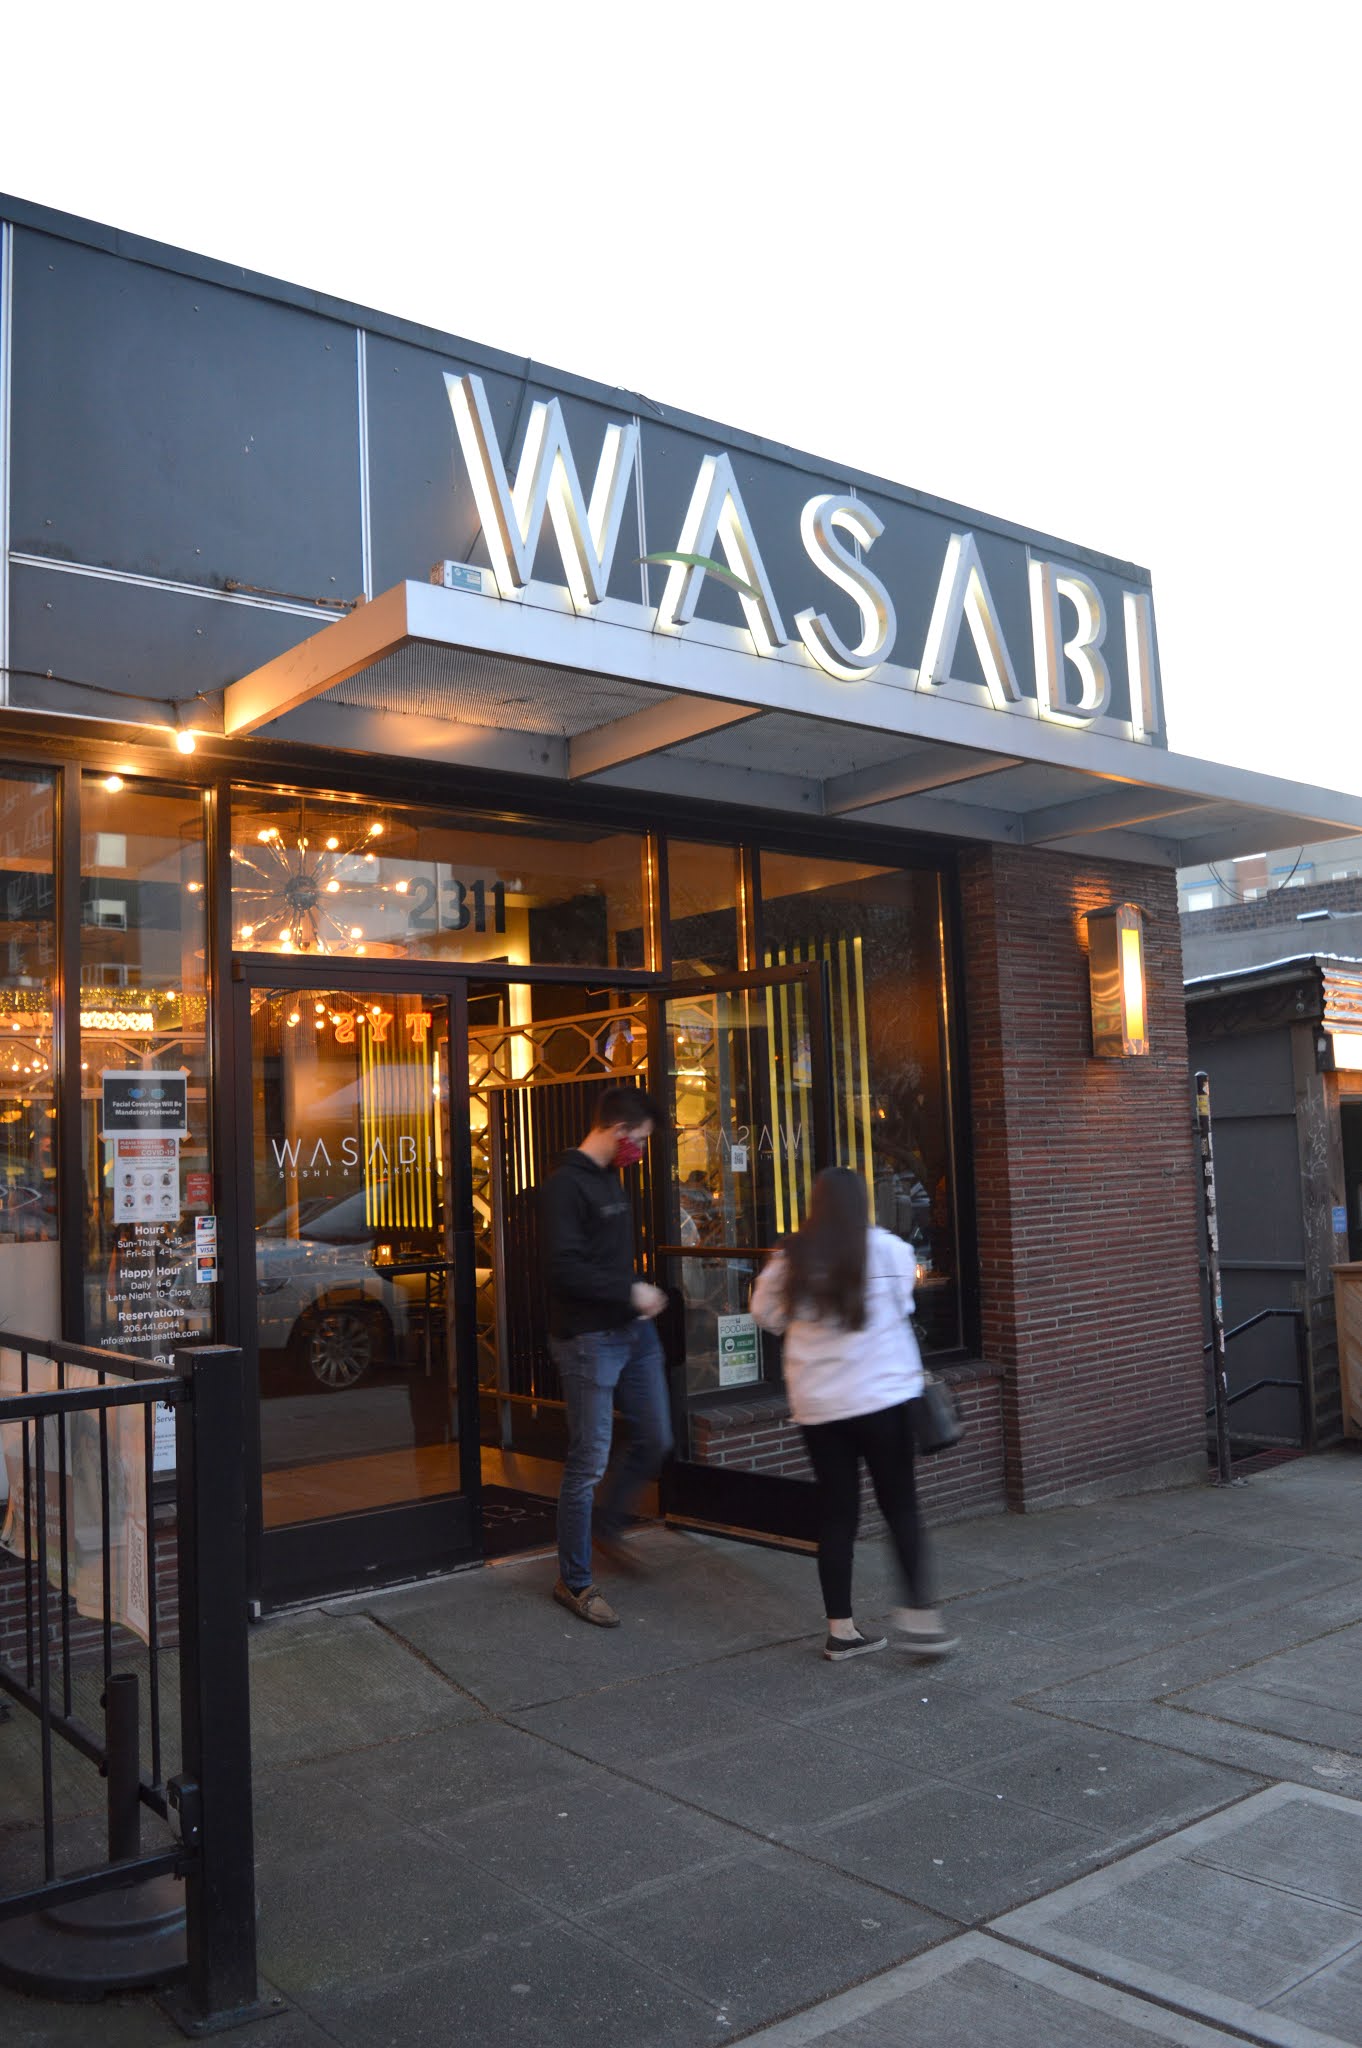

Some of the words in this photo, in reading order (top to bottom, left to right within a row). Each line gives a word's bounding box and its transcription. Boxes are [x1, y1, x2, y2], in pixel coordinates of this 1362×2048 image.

[442, 371, 1158, 743] WASABI
[407, 877, 507, 933] 2311
[131, 1101, 161, 1109] Coverings
[271, 1136, 431, 1168] WASABI
[279, 1170, 329, 1178] SUSHI
[343, 1168, 349, 1176] &
[135, 1226, 165, 1235] Hours
[118, 1239, 160, 1248] Sun-Thurs
[126, 1249, 155, 1257] Fri-Sat
[120, 1269, 154, 1279] Happy
[156, 1267, 182, 1276] Hour
[131, 1282, 151, 1290] Daily
[108, 1294, 127, 1302] Late
[129, 1292, 151, 1301] Night
[156, 1289, 191, 1298] 10-Close
[118, 1308, 185, 1321] Reservations
[123, 1321, 180, 1333] 206.441.6044
[720, 1325, 741, 1334] FOOD
[100, 1329, 200, 1346] info@wasabiseattle.com
